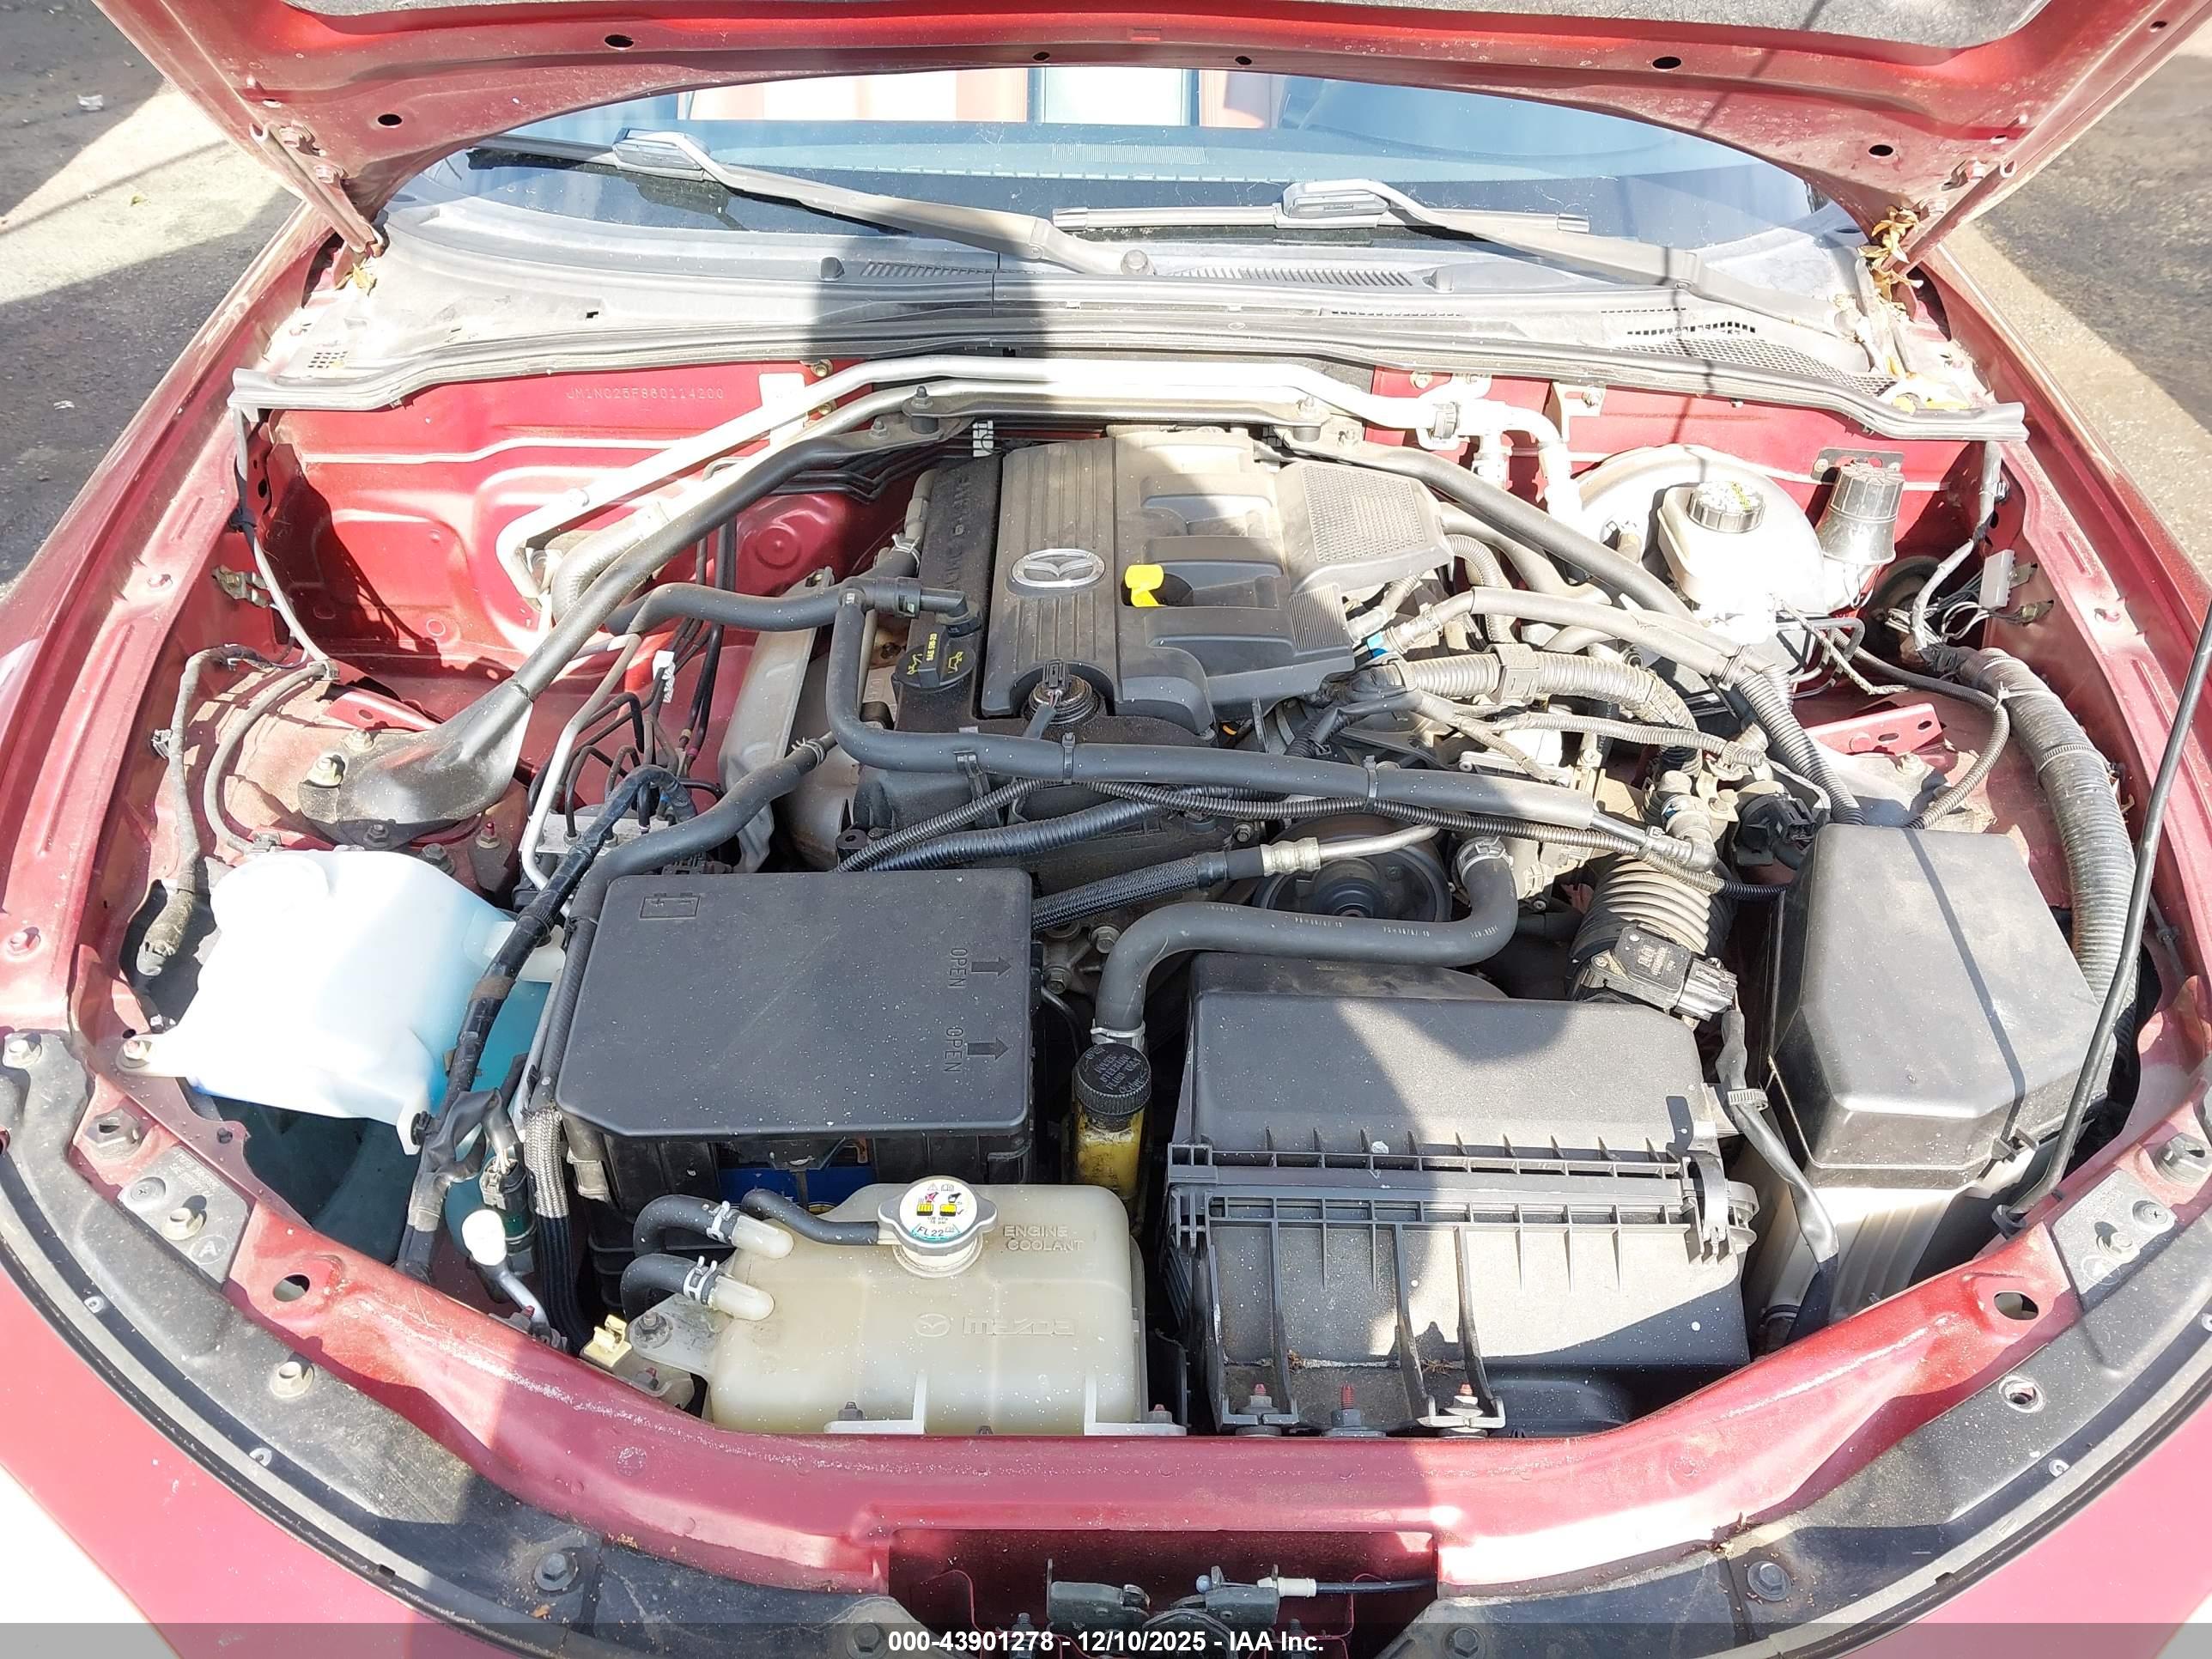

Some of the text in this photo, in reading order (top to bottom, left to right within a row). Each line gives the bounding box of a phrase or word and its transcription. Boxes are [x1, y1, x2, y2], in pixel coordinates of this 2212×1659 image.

[947, 947, 968, 988] OPEN
[942, 1027, 964, 1073] OPEN
[917, 1225, 945, 1237] FL22
[1003, 1224, 1069, 1238] ENGINE
[1006, 1238, 1085, 1251] COOLANT
